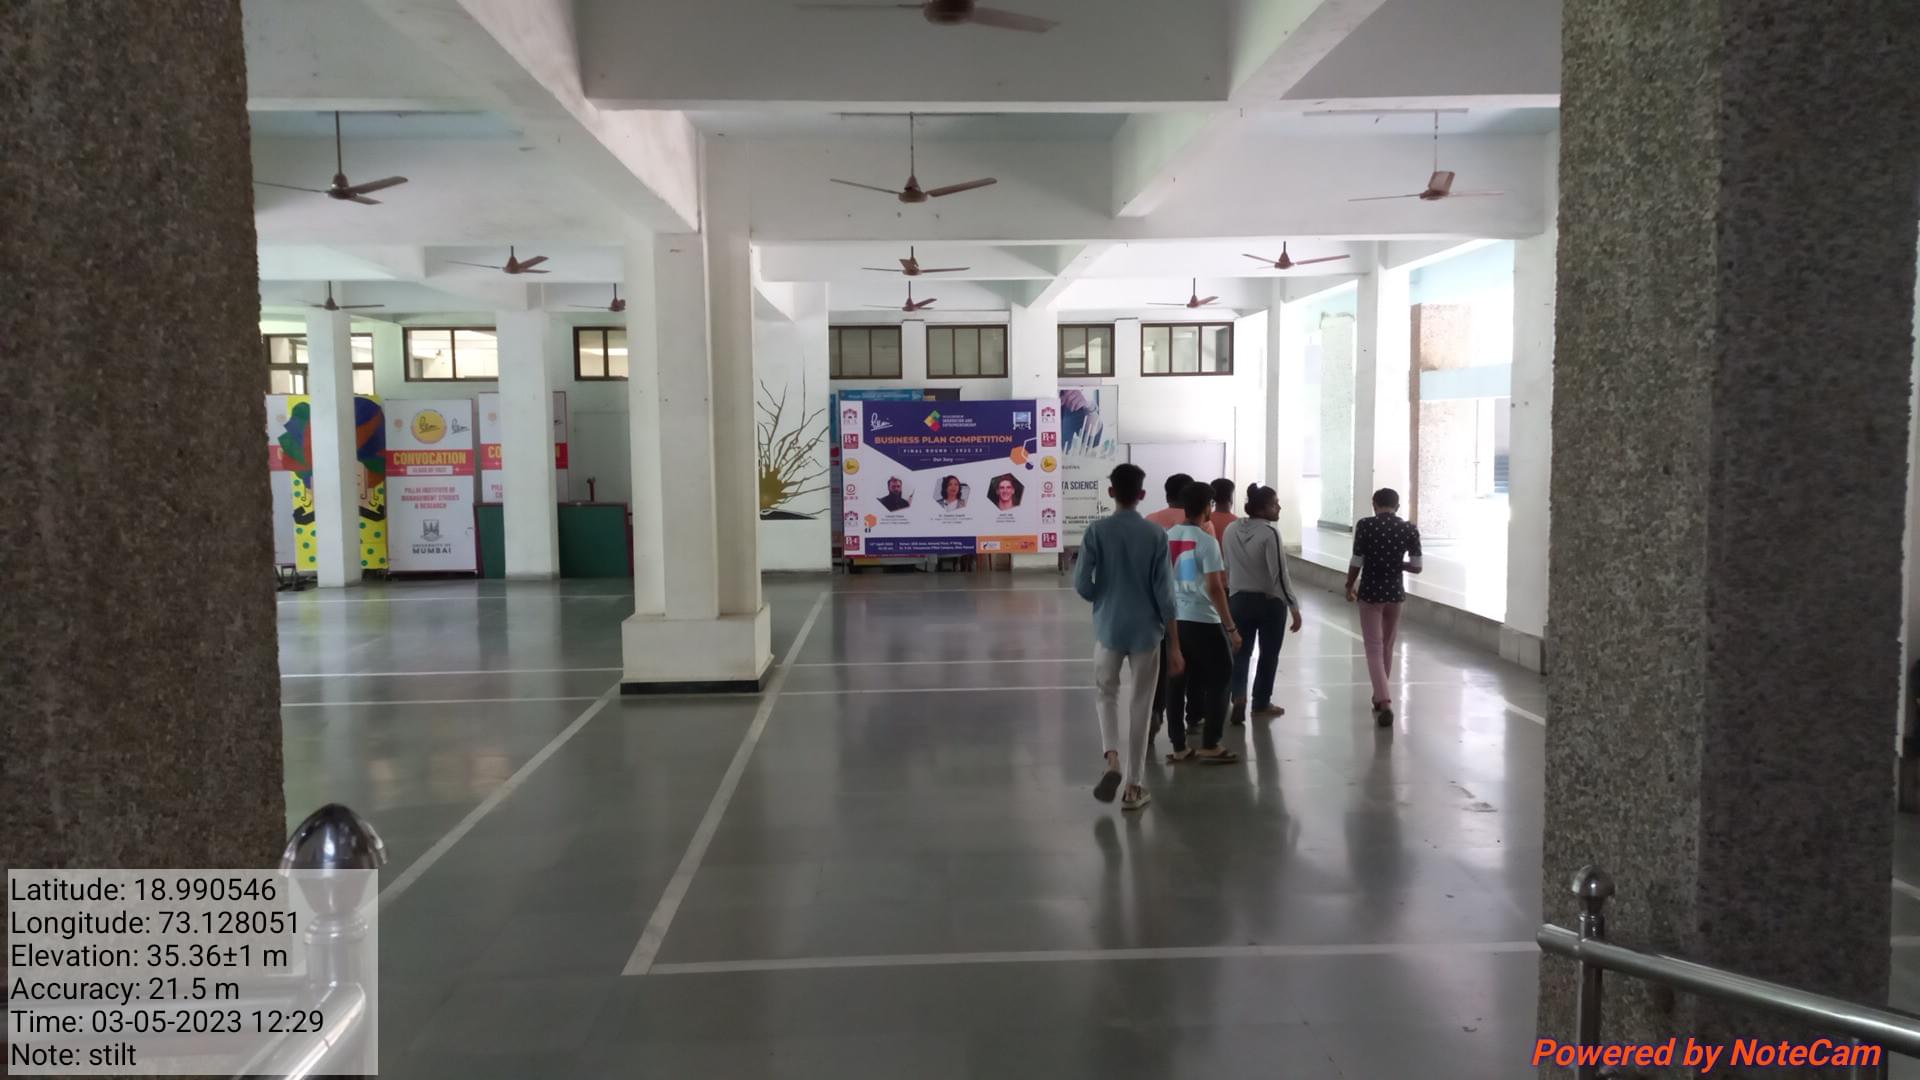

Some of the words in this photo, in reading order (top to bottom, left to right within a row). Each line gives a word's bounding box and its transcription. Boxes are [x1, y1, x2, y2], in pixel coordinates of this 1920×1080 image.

[874, 435, 920, 445] BUSINESS
[922, 435, 947, 444] PLAN
[948, 435, 1013, 444] COMPETITION
[393, 451, 467, 465] CONVOCATION
[1070, 480, 1098, 490] SCIENCE
